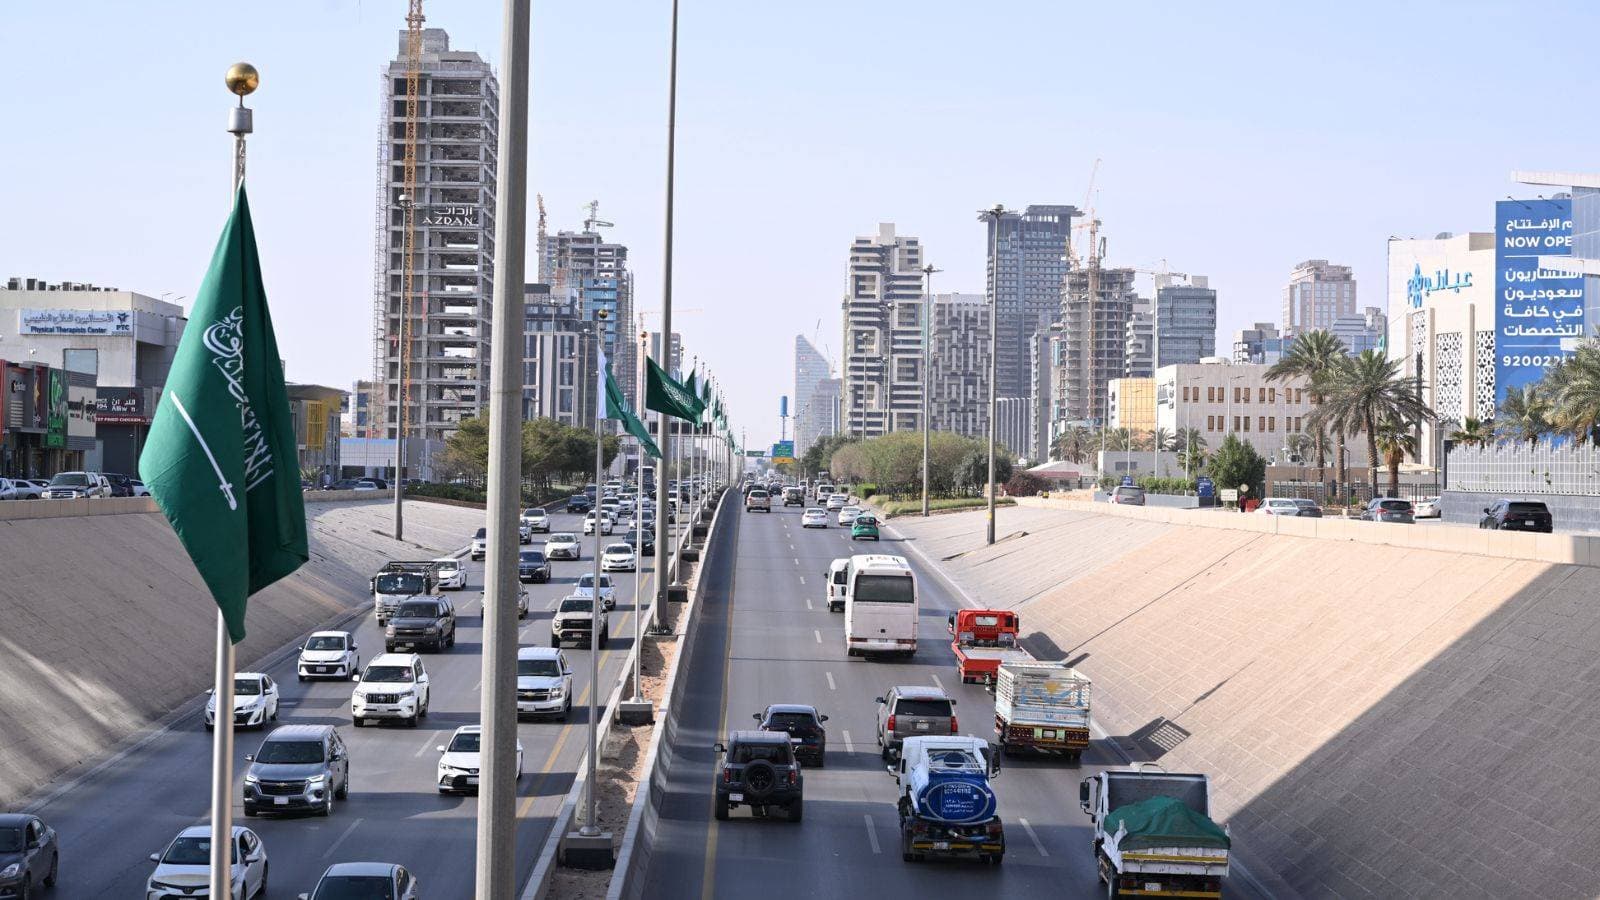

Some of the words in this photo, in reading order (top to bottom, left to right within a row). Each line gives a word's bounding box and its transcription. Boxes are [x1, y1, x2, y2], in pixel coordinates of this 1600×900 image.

[422, 216, 474, 226] AZDAN
[1562, 220, 1572, 229] م
[1504, 236, 1540, 248] NOW
[1544, 236, 1572, 247] OPE
[1504, 286, 1583, 301] سعوديون
[1504, 304, 1549, 318] كافة
[1553, 304, 1583, 323] في
[30, 326, 54, 334] Physical
[56, 326, 86, 334] Therapists
[87, 326, 107, 334] Center
[1504, 324, 1583, 337] التخصصات
